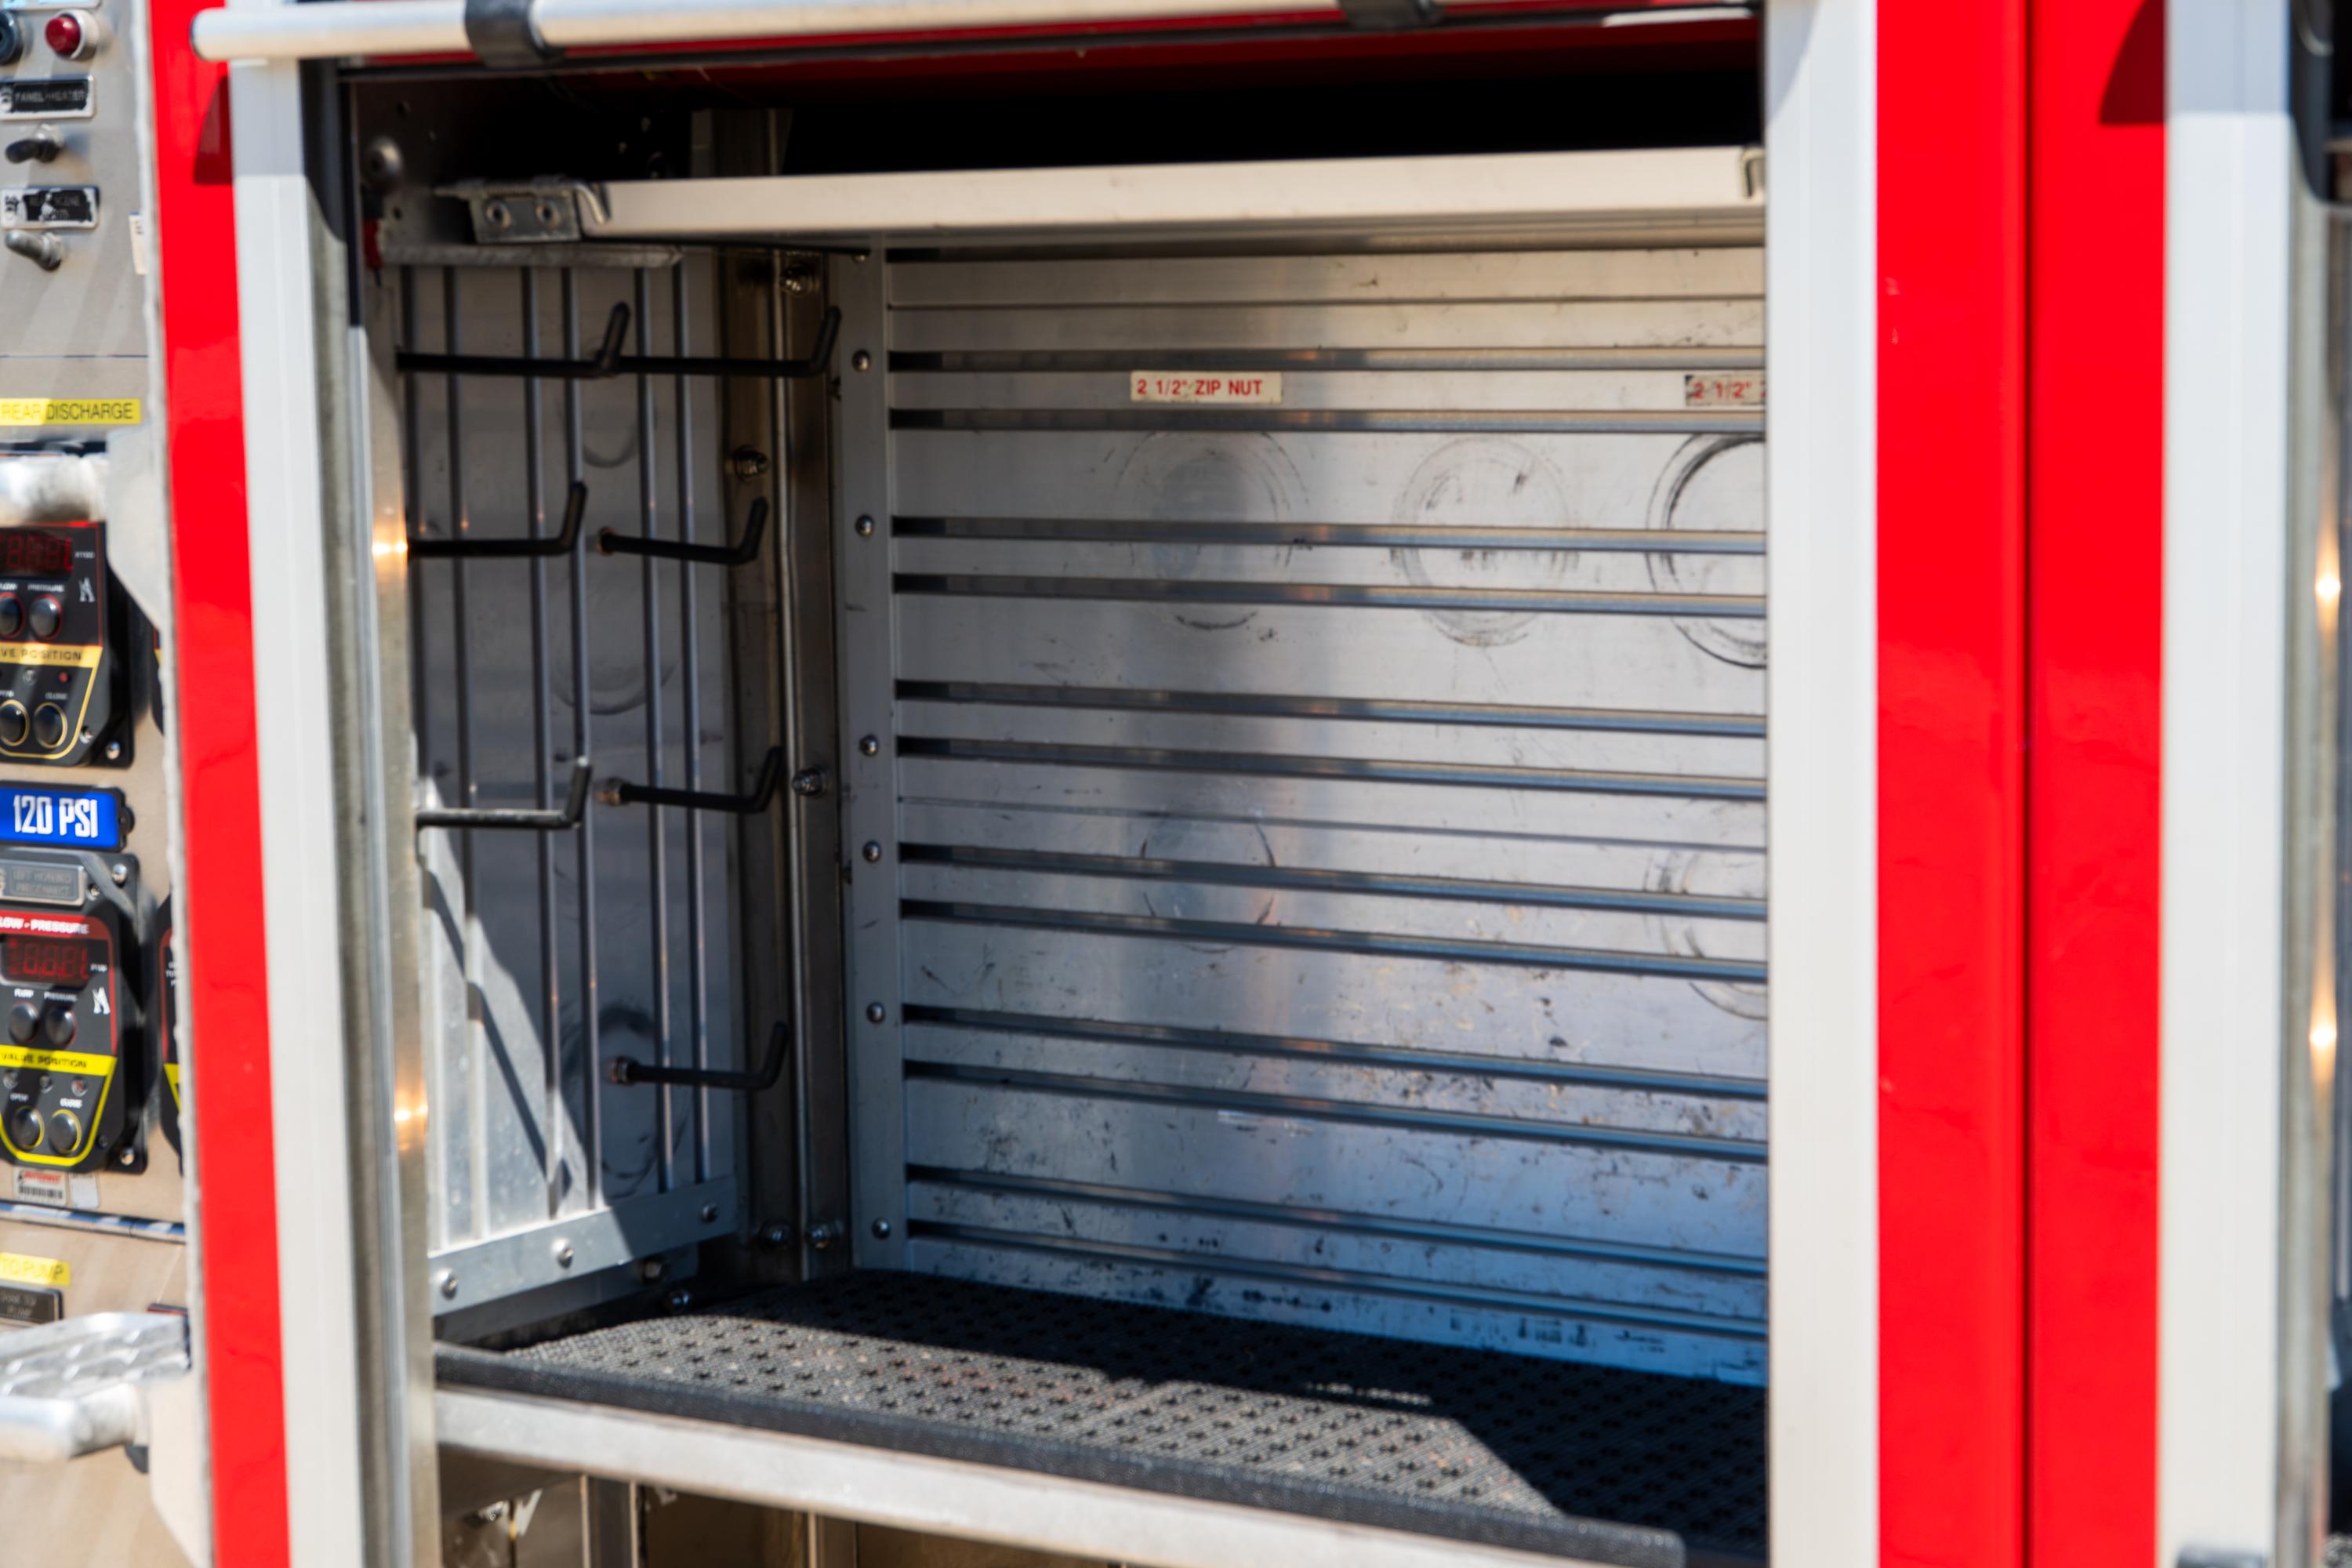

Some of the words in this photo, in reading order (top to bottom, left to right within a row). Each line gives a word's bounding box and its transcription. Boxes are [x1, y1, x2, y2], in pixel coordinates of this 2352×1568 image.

[1137, 379, 1147, 395] 2
[1195, 380, 1221, 395] ZIP
[1229, 379, 1263, 395] NUT
[1693, 382, 1705, 399] 2
[47, 402, 133, 420] DISCHARGE
[21, 649, 82, 660] POSITION
[13, 794, 53, 834] 120
[59, 797, 98, 838] PSI
[30, 919, 89, 935] PRESSURE
